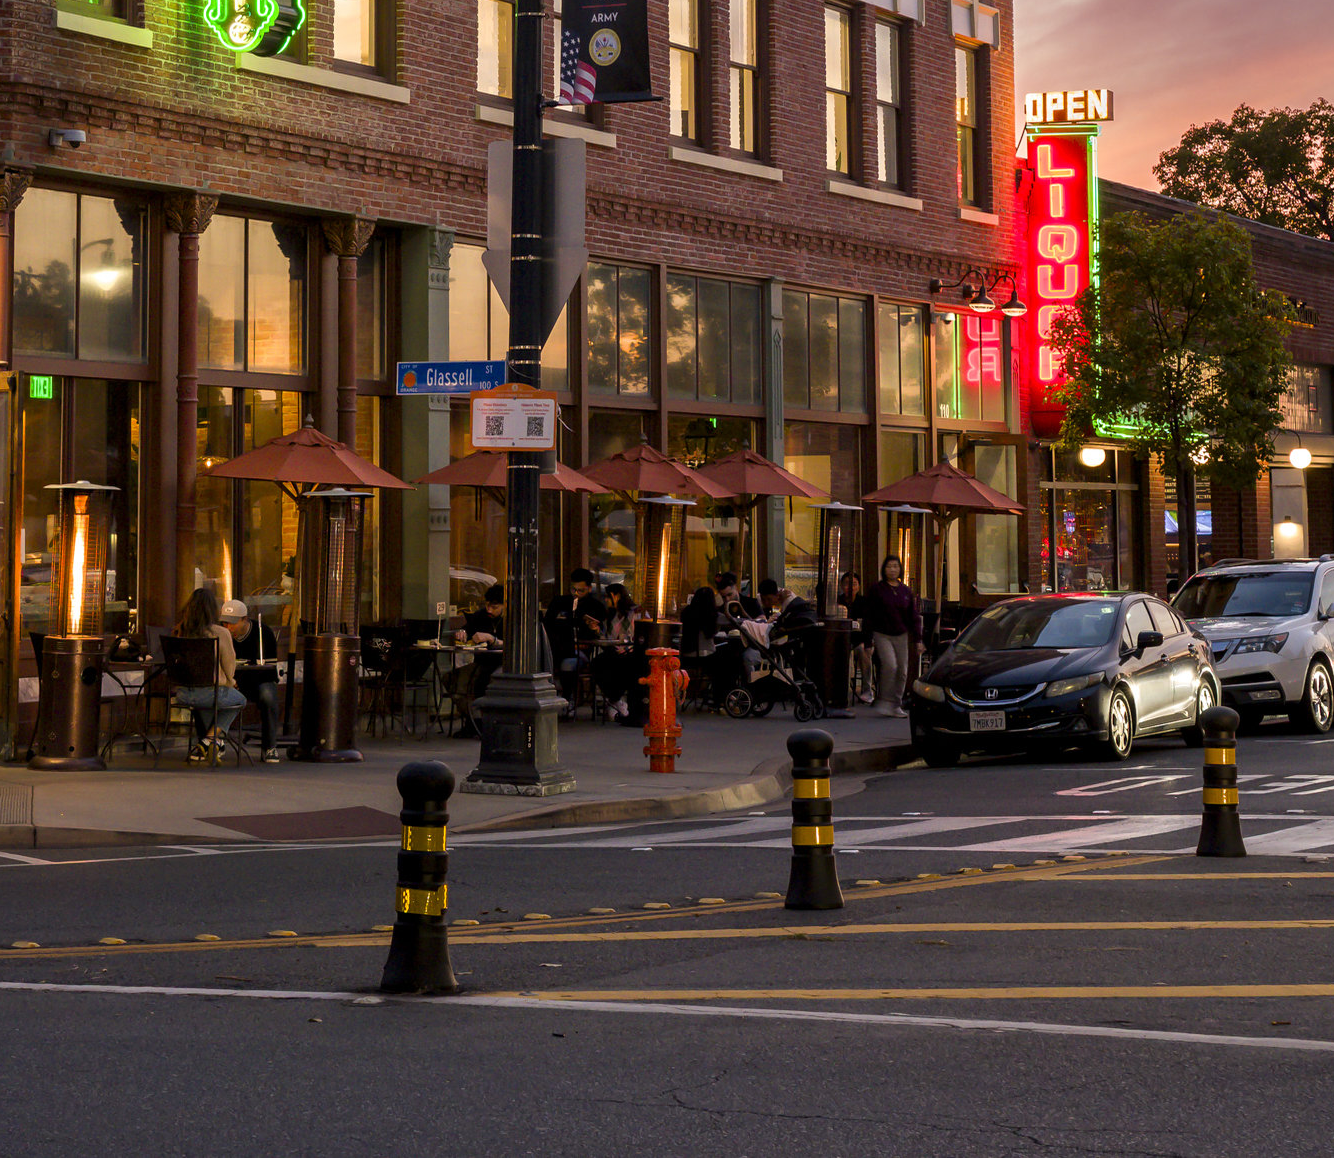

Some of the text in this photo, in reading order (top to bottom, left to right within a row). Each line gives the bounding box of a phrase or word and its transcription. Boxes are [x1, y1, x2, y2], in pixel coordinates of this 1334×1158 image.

[591, 12, 619, 23] ARMY
[1026, 89, 1109, 123] OPEN
[485, 365, 493, 374] ST
[427, 368, 473, 386] Glassell
[479, 381, 491, 390] 100
[939, 404, 950, 418] 110
[972, 718, 1003, 728] 7MBK917
